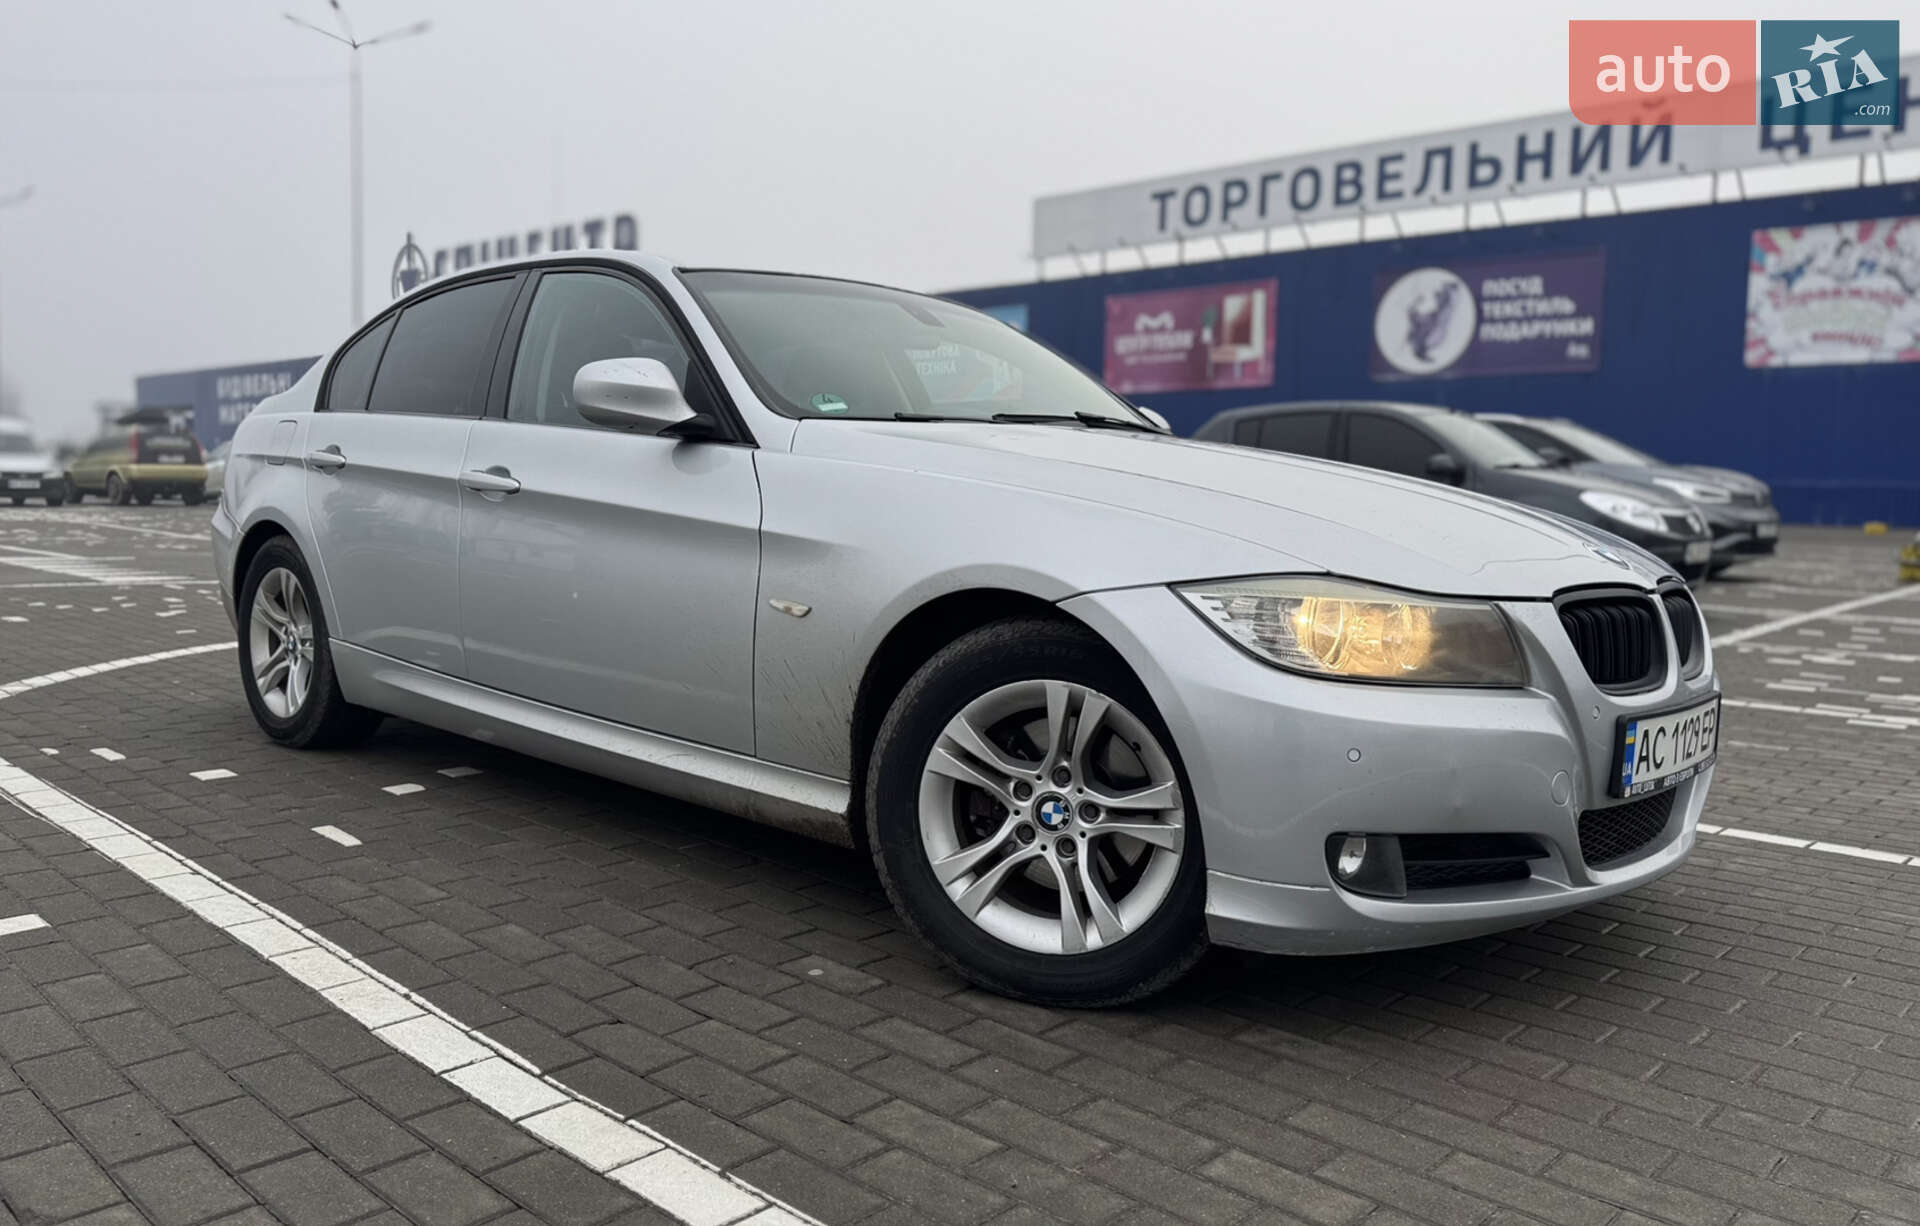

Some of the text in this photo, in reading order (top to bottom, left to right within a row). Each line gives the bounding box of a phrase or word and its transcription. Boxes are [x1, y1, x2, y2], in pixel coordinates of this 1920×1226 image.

[1150, 98, 1674, 232] ТОРГОВЕЛЬНИЙ
[1482, 296, 1576, 319] ТЕКСТИЛЬ
[1636, 726, 1666, 775] AC
